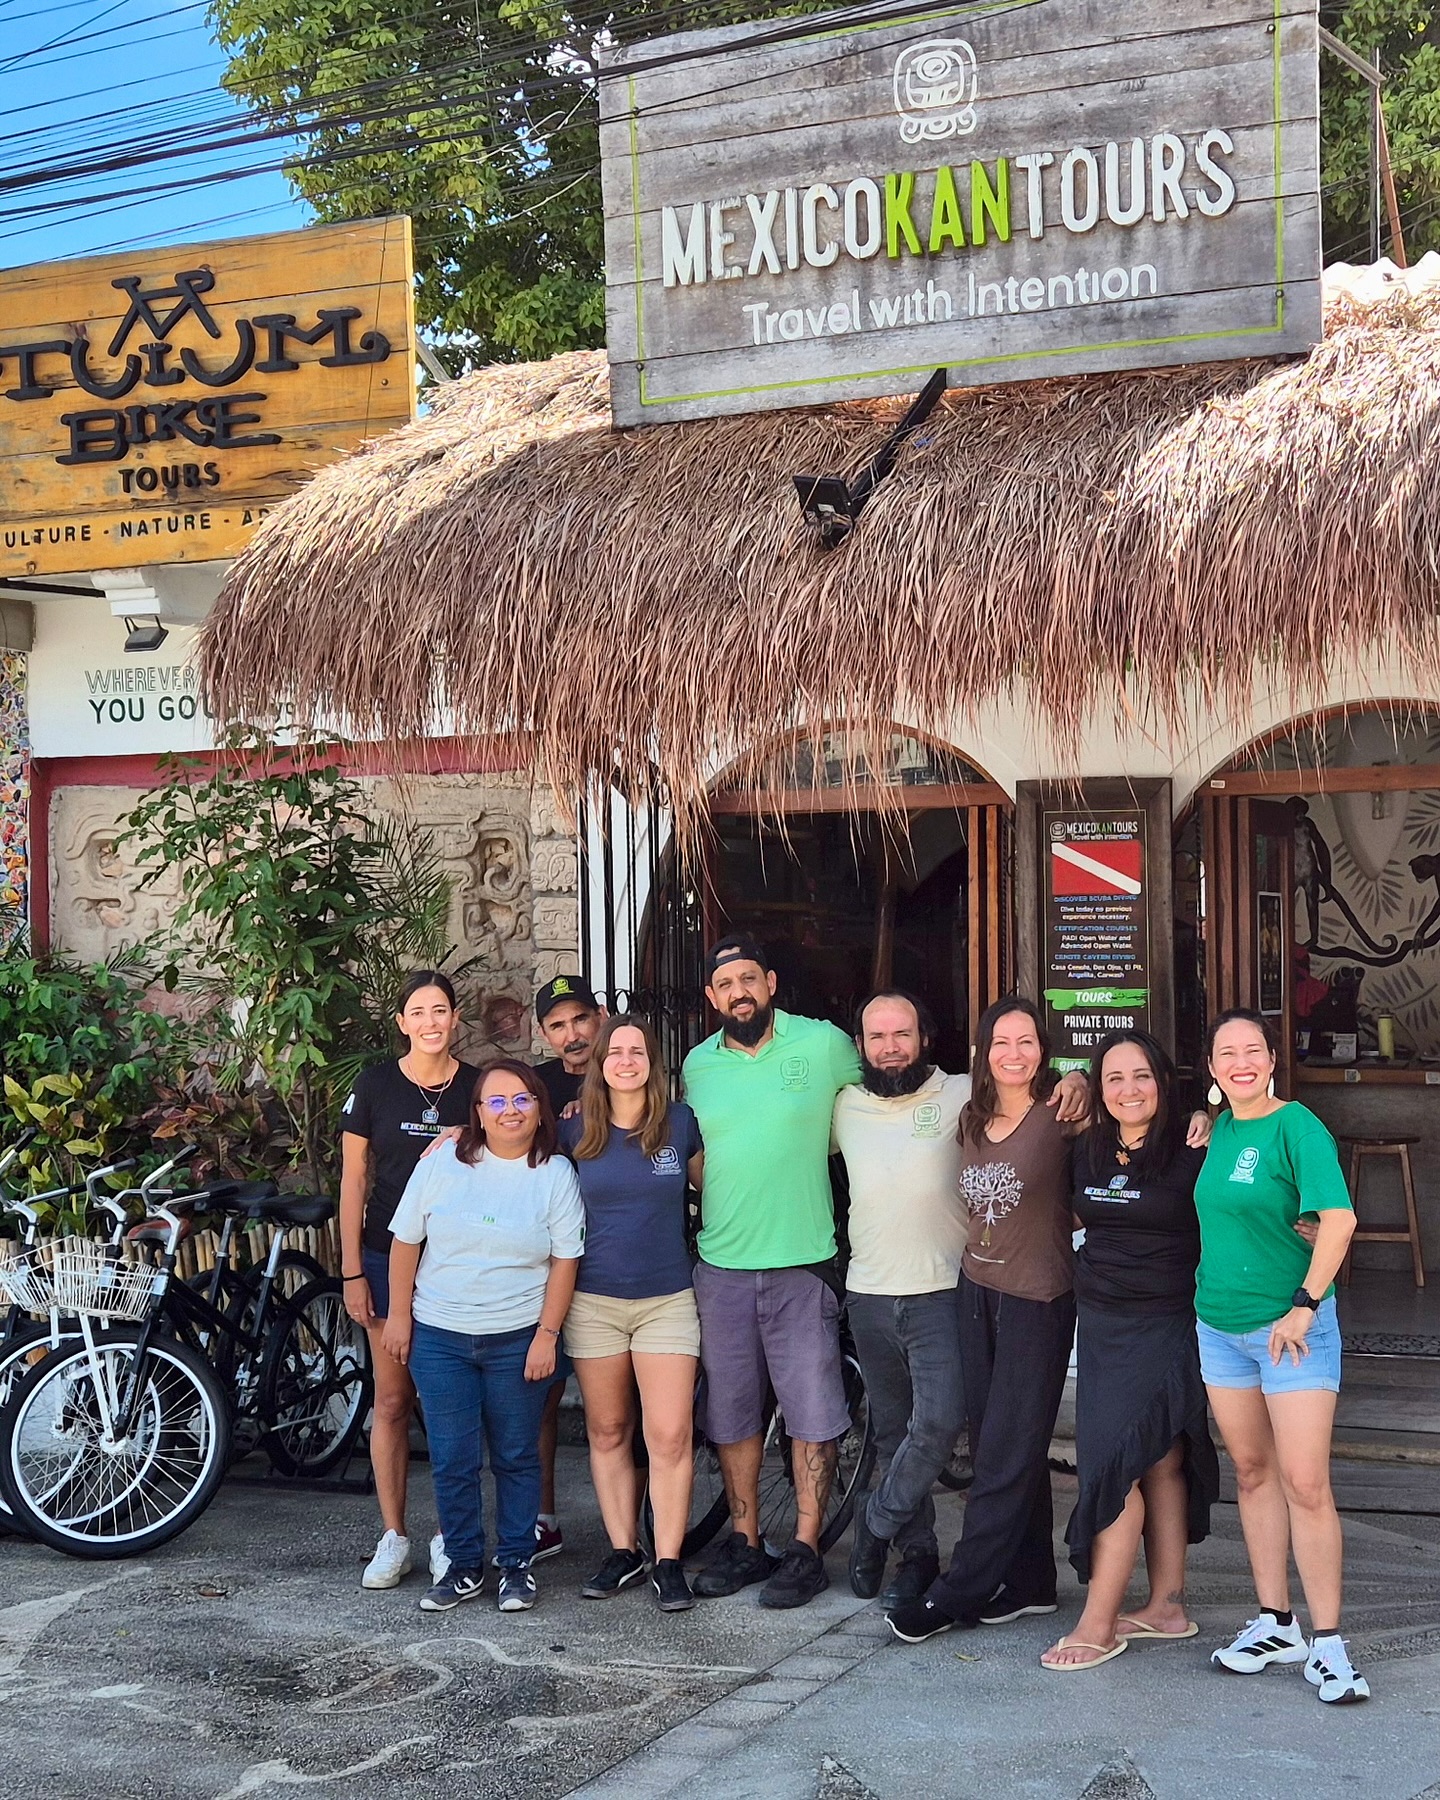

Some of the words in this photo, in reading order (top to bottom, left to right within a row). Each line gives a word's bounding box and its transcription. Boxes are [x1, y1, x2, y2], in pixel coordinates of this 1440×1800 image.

[662, 128, 1236, 288] MEXICOKANTOURS
[742, 286, 861, 346] Travel
[868, 279, 952, 328] with
[968, 263, 1157, 317] Intention
[0, 307, 391, 400] TULUM
[56, 393, 282, 465] BIKE
[118, 462, 220, 494] TOURS
[120, 513, 211, 538] NATURE
[85, 666, 195, 694] WHEREVER
[88, 697, 145, 724] YOU
[1066, 821, 1138, 834] MEXICOKANTOURS
[1079, 934, 1097, 942] Open
[1093, 942, 1111, 950] Open
[1075, 991, 1113, 1003] TOURS
[1063, 1014, 1102, 1029] PRIVATE
[1103, 1015, 1134, 1029] TOURS
[1072, 1032, 1093, 1046] BIKE
